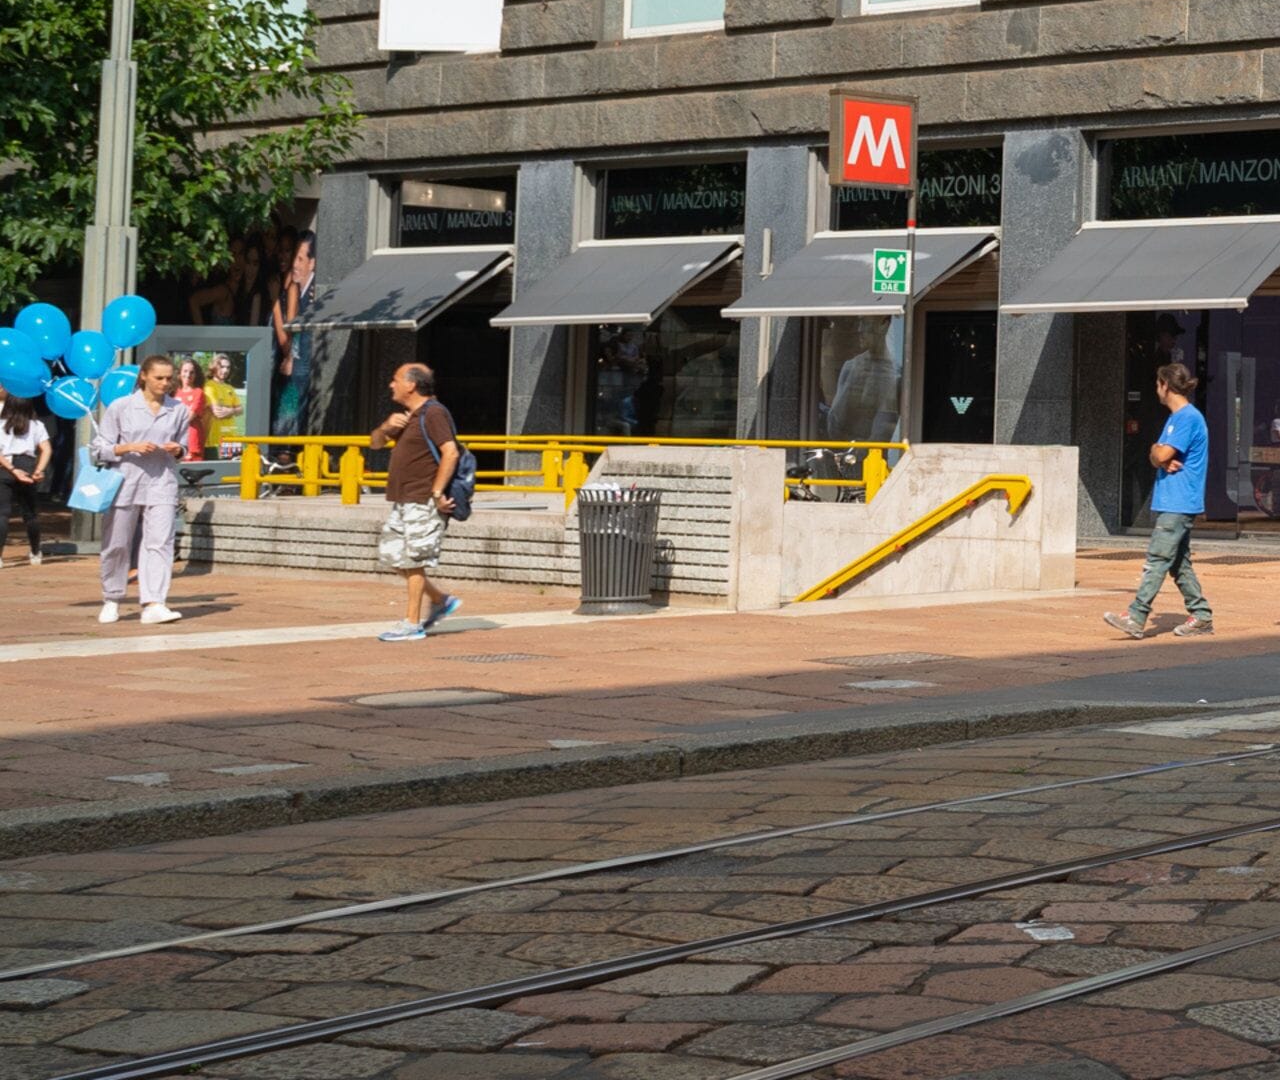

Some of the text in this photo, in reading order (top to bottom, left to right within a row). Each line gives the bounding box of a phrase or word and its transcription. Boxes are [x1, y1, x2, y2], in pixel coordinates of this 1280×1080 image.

[847, 115, 906, 169] M
[1120, 164, 1184, 188] ARMANI
[662, 190, 726, 210] MANZONI
[447, 208, 502, 228] MANZONI
[880, 282, 899, 292] DAE
